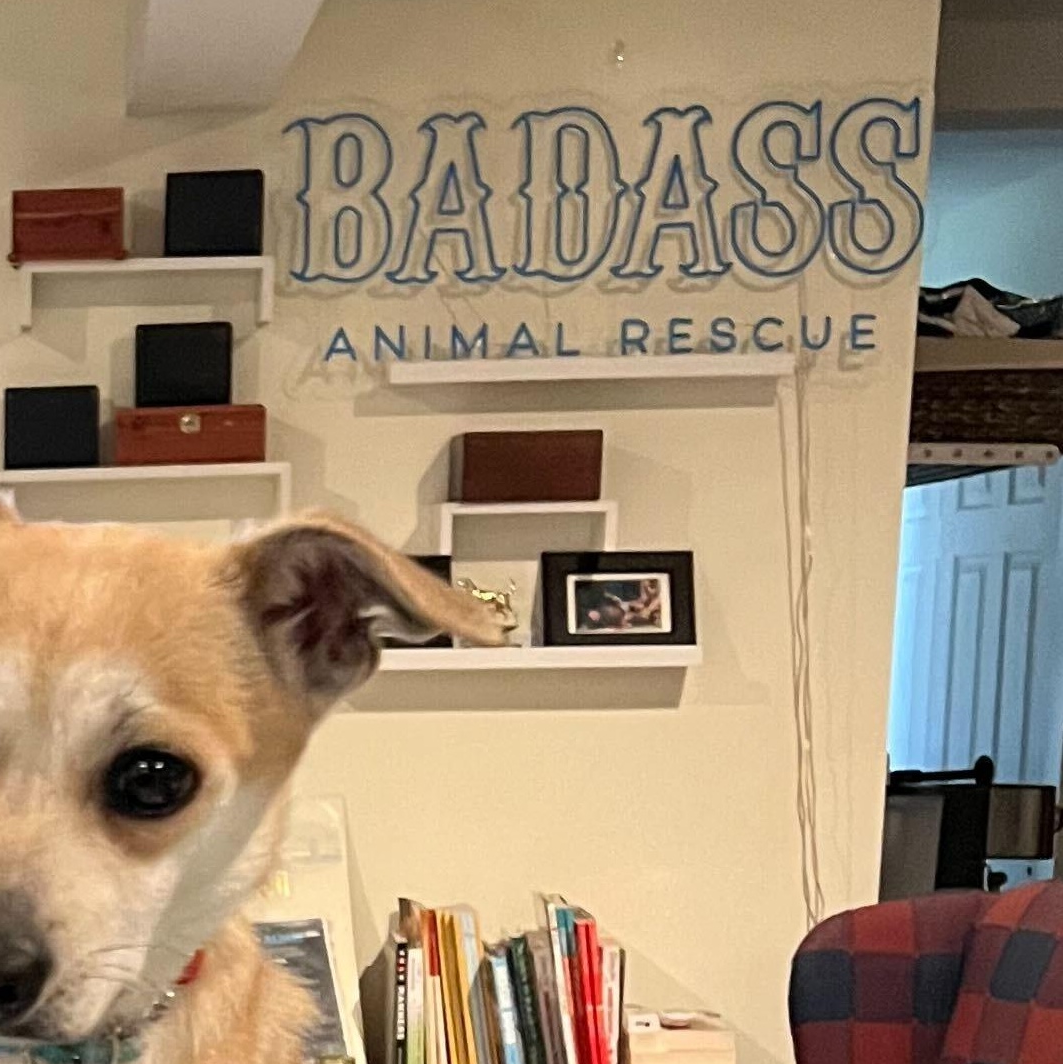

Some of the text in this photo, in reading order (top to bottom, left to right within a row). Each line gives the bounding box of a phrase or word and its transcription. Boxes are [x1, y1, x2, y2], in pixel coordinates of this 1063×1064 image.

[283, 96, 924, 284] BADASS
[324, 314, 878, 362] ANIMAL RESCUE
